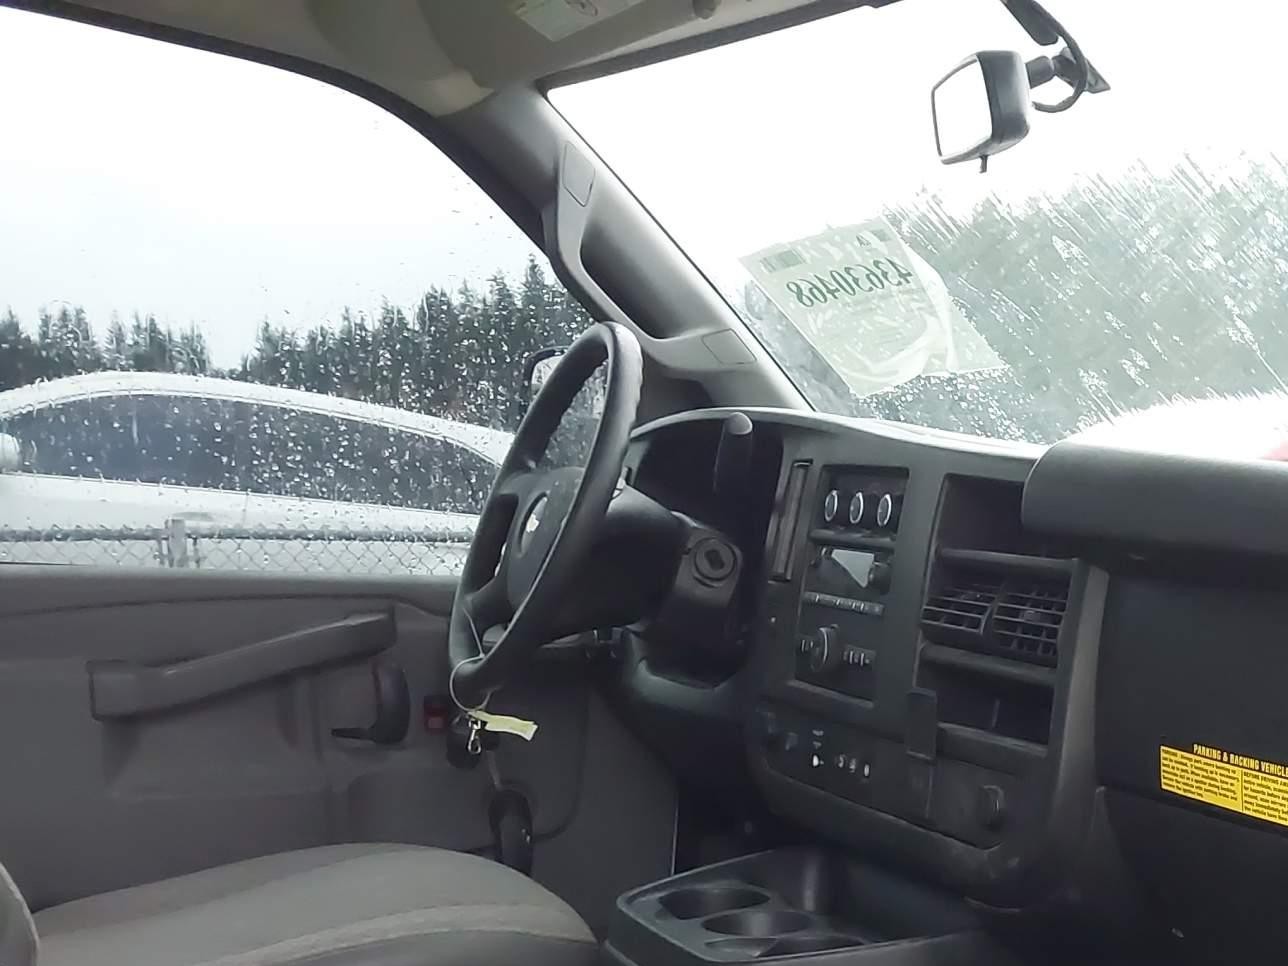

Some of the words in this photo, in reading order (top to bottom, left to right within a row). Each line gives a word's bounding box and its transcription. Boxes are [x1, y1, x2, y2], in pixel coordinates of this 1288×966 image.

[1193, 743, 1222, 760] PARKING
[1222, 752, 1228, 762] &
[1230, 754, 1260, 770] BACKING
